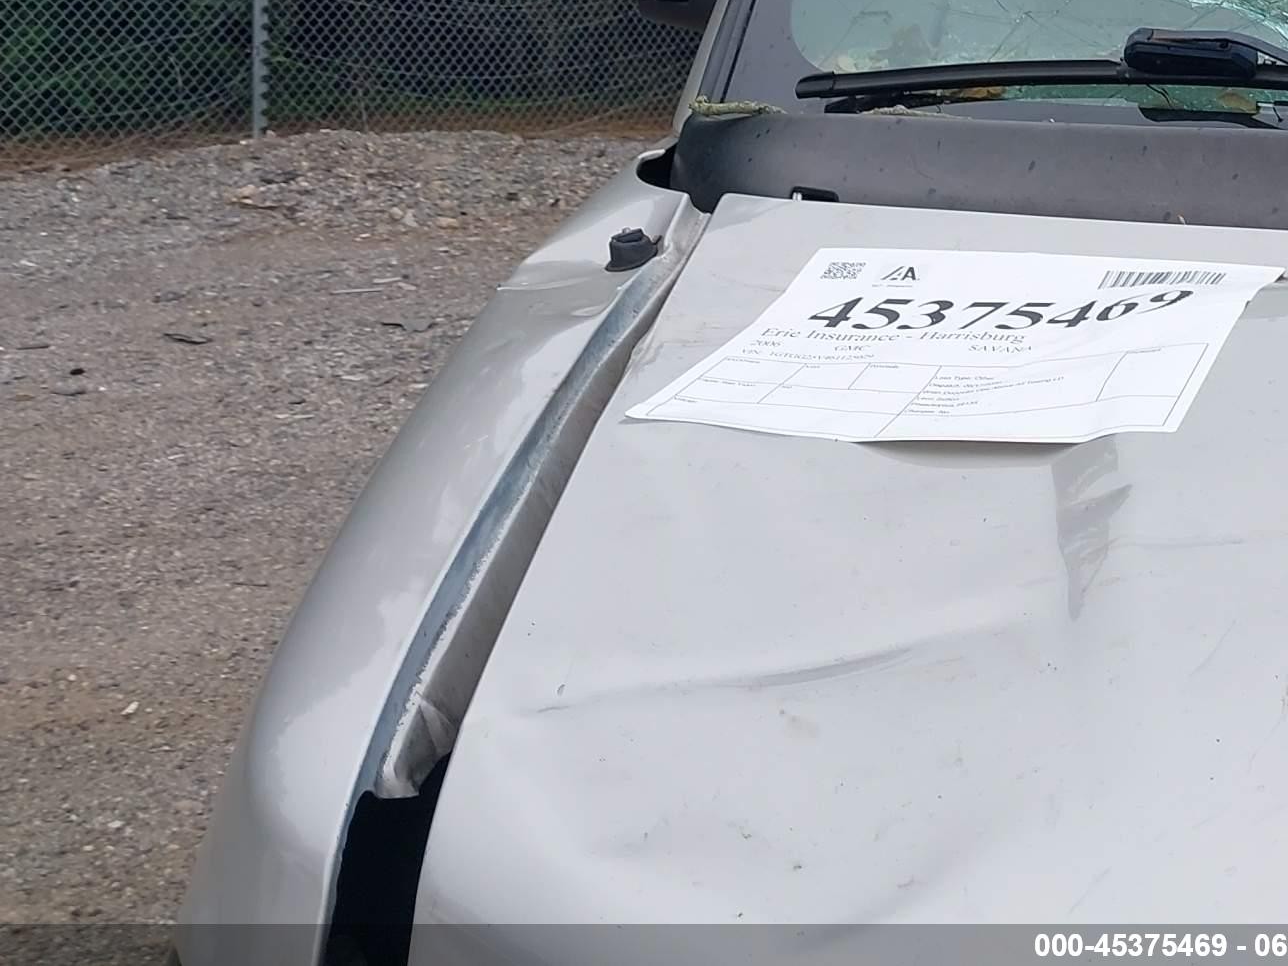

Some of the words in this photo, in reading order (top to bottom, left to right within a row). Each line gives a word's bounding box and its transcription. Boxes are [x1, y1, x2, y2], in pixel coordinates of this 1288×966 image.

[808, 290, 1194, 330] 45375469
[761, 328, 801, 339] Erie
[807, 330, 900, 342] Insurance
[920, 330, 1026, 344] Harrisburg
[834, 344, 871, 352] GMC
